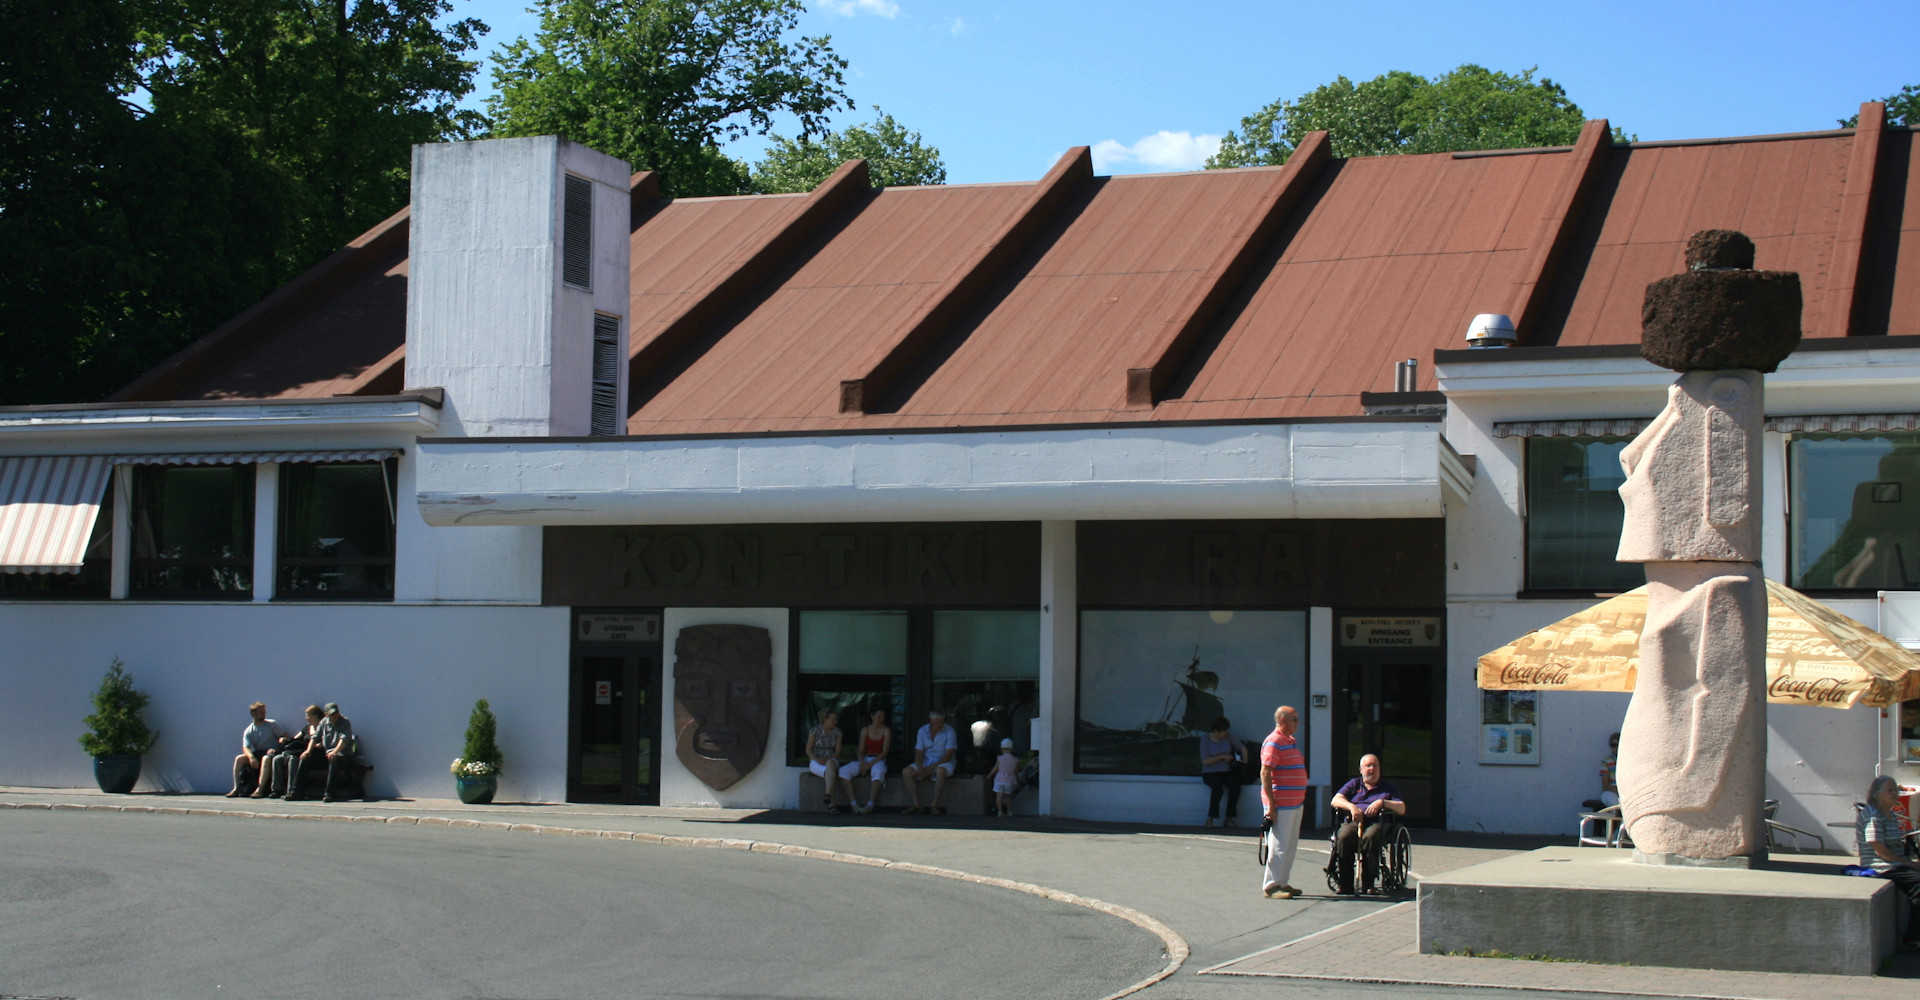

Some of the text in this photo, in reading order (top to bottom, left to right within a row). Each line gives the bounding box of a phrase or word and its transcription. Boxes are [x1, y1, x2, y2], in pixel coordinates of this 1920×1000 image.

[1188, 528, 1310, 588] RA
[1368, 637, 1414, 645] ENTRANCE
[1501, 662, 1574, 685] Coca-Cola
[1768, 674, 1850, 703] Coca-Cola
